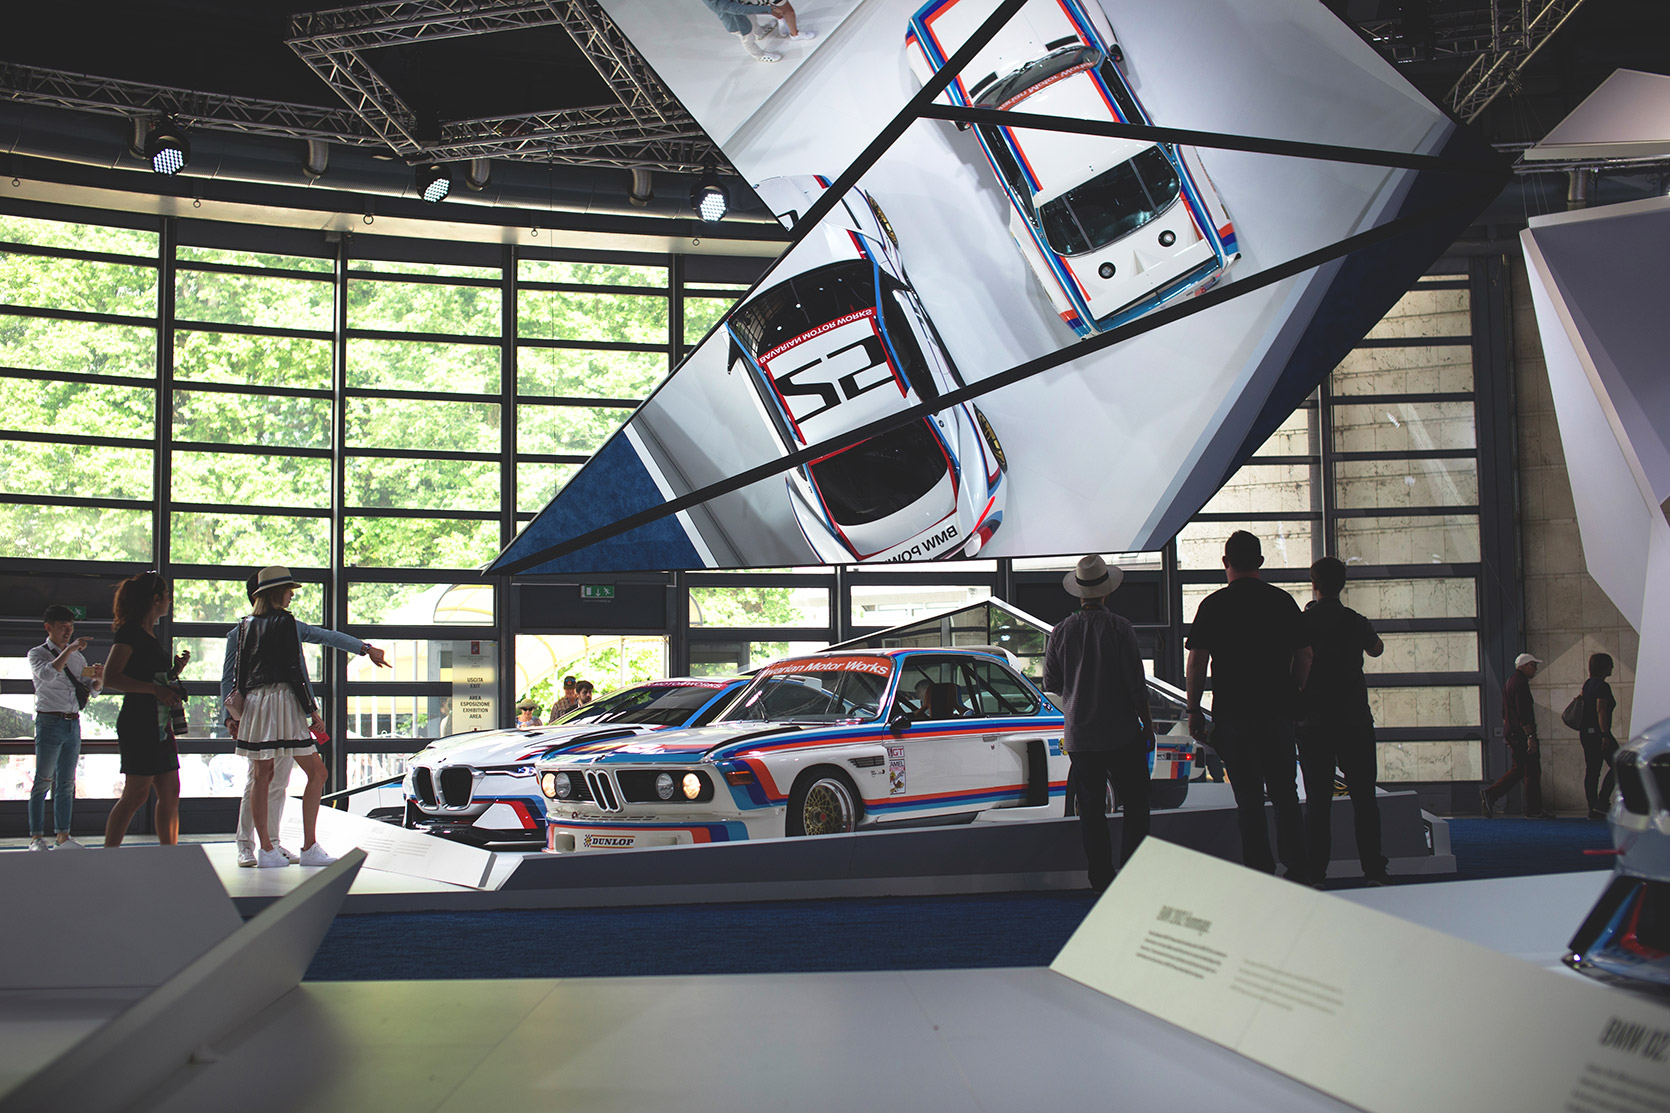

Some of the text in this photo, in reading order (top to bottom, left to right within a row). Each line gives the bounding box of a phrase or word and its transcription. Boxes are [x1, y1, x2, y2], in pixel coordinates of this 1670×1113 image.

[804, 661, 845, 672] Motor
[844, 660, 889, 675] Works
[892, 748, 904, 757] GT
[889, 760, 904, 768] AMEL
[592, 837, 634, 846] DUNLOP
[1600, 1017, 1648, 1054] BMW
